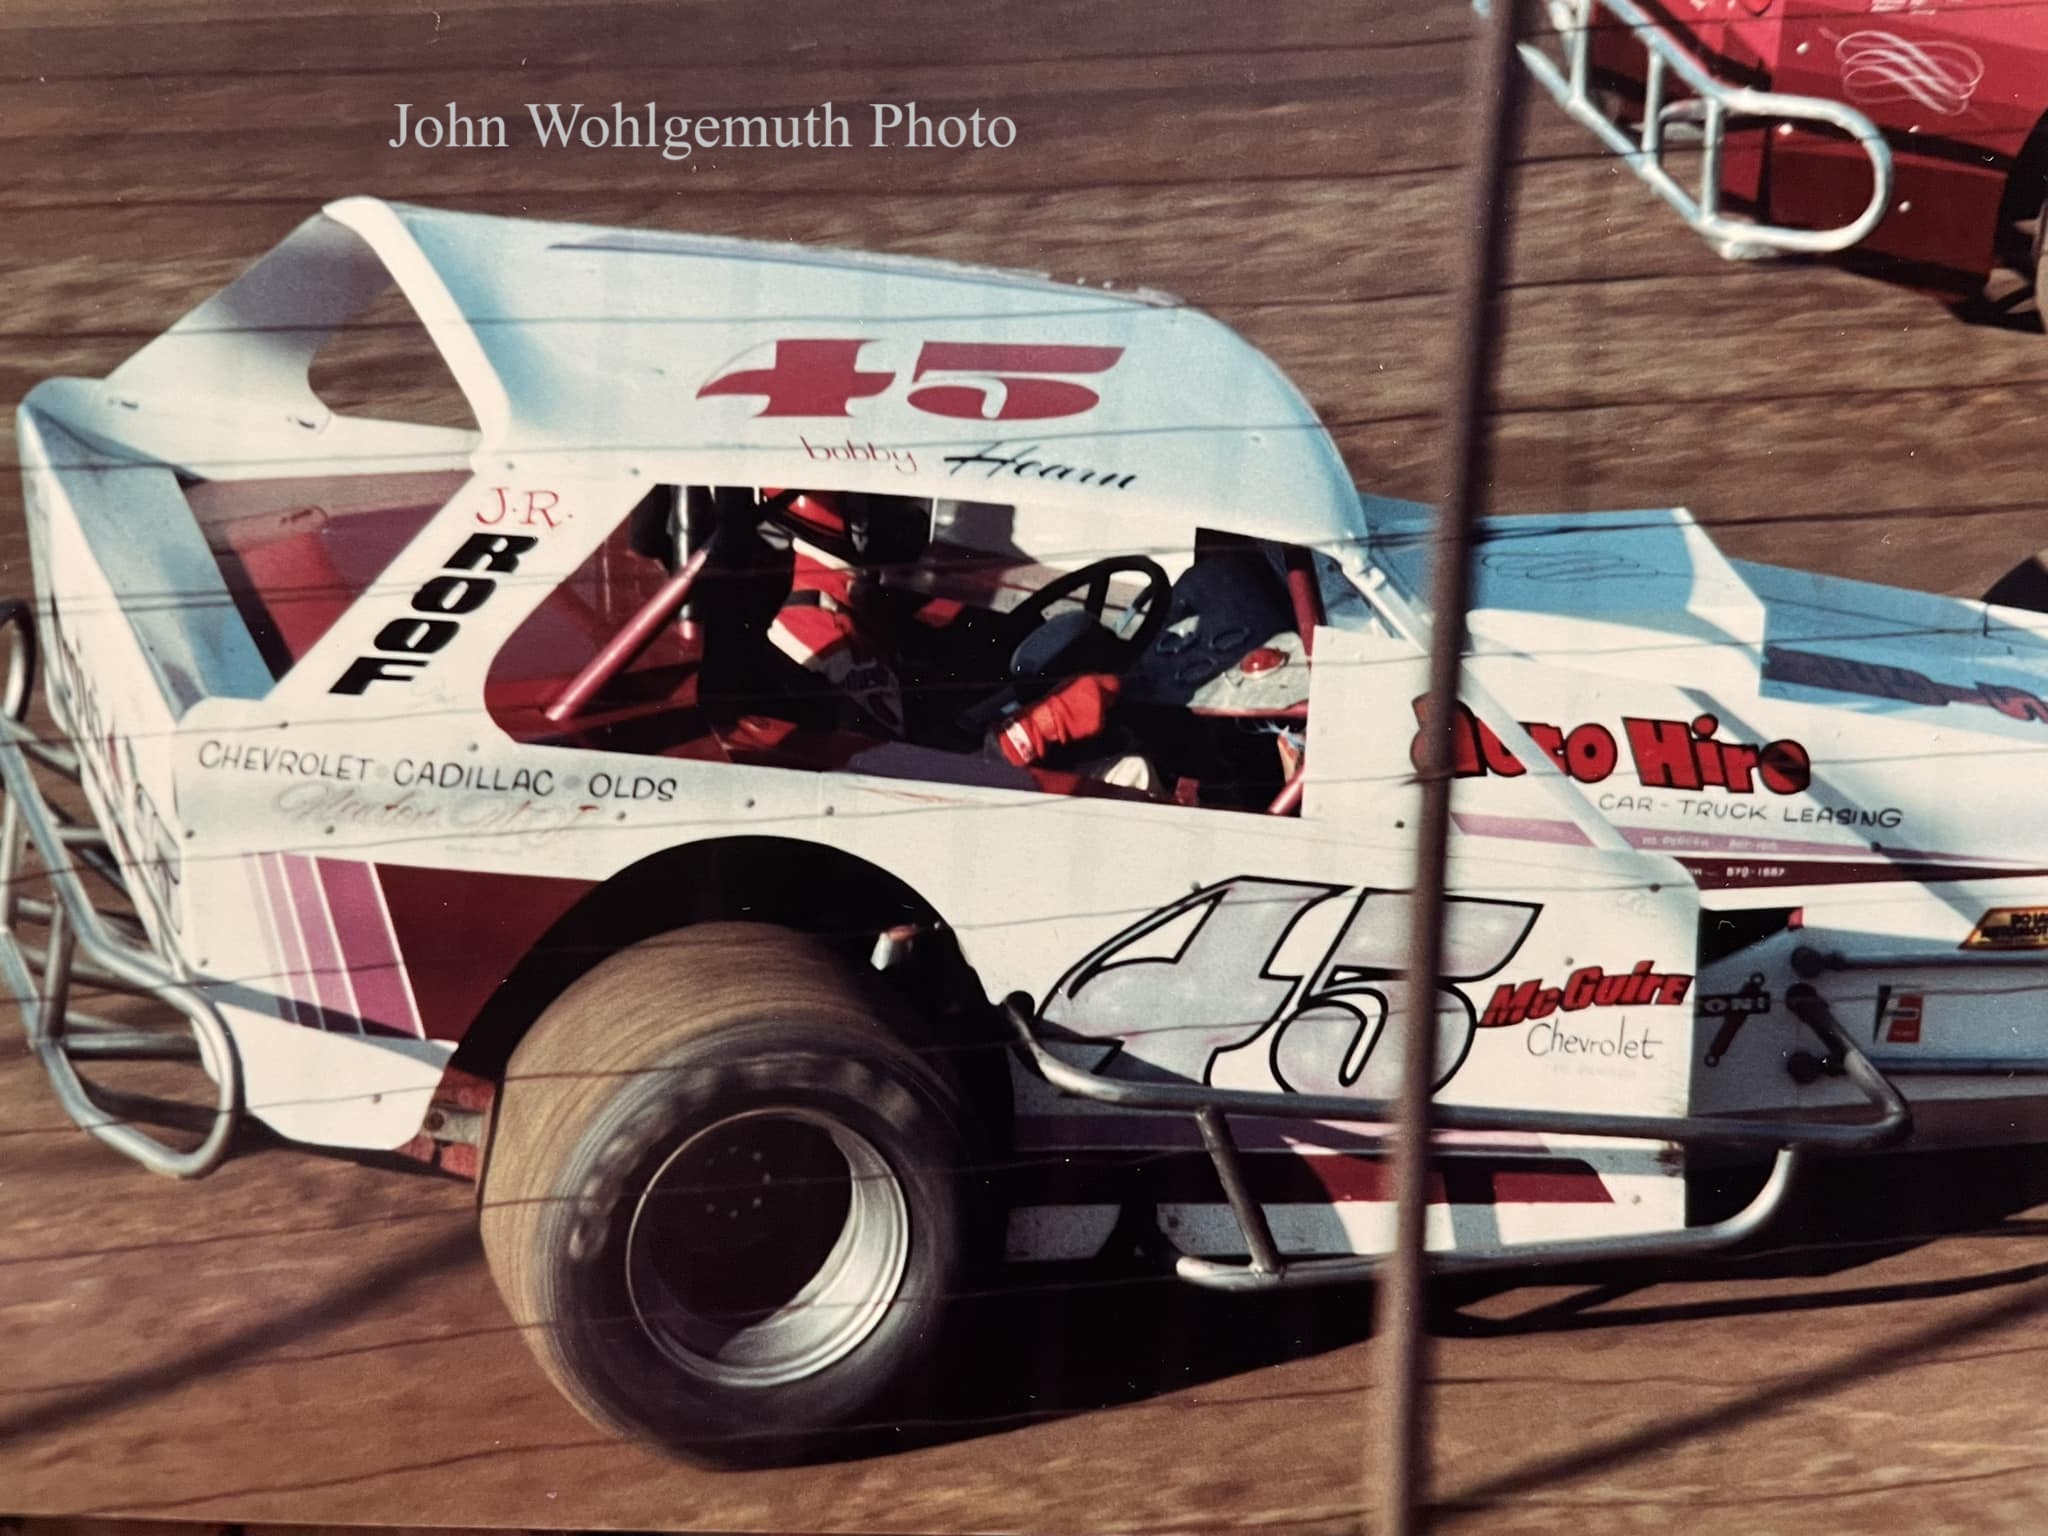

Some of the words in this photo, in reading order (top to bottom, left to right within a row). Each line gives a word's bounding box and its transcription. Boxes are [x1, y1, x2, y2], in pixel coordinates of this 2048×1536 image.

[695, 338, 1126, 421] 45
[327, 532, 540, 696] ROOF
[198, 740, 374, 782] CHEVROLET
[393, 759, 555, 797] CADILLAC
[587, 773, 679, 802] OLDS
[1782, 807, 1904, 829] LEASING
[1034, 874, 1545, 1098] 45
[1698, 996, 1766, 1014] ONI
[1526, 1015, 1664, 1060] Chevrolet
